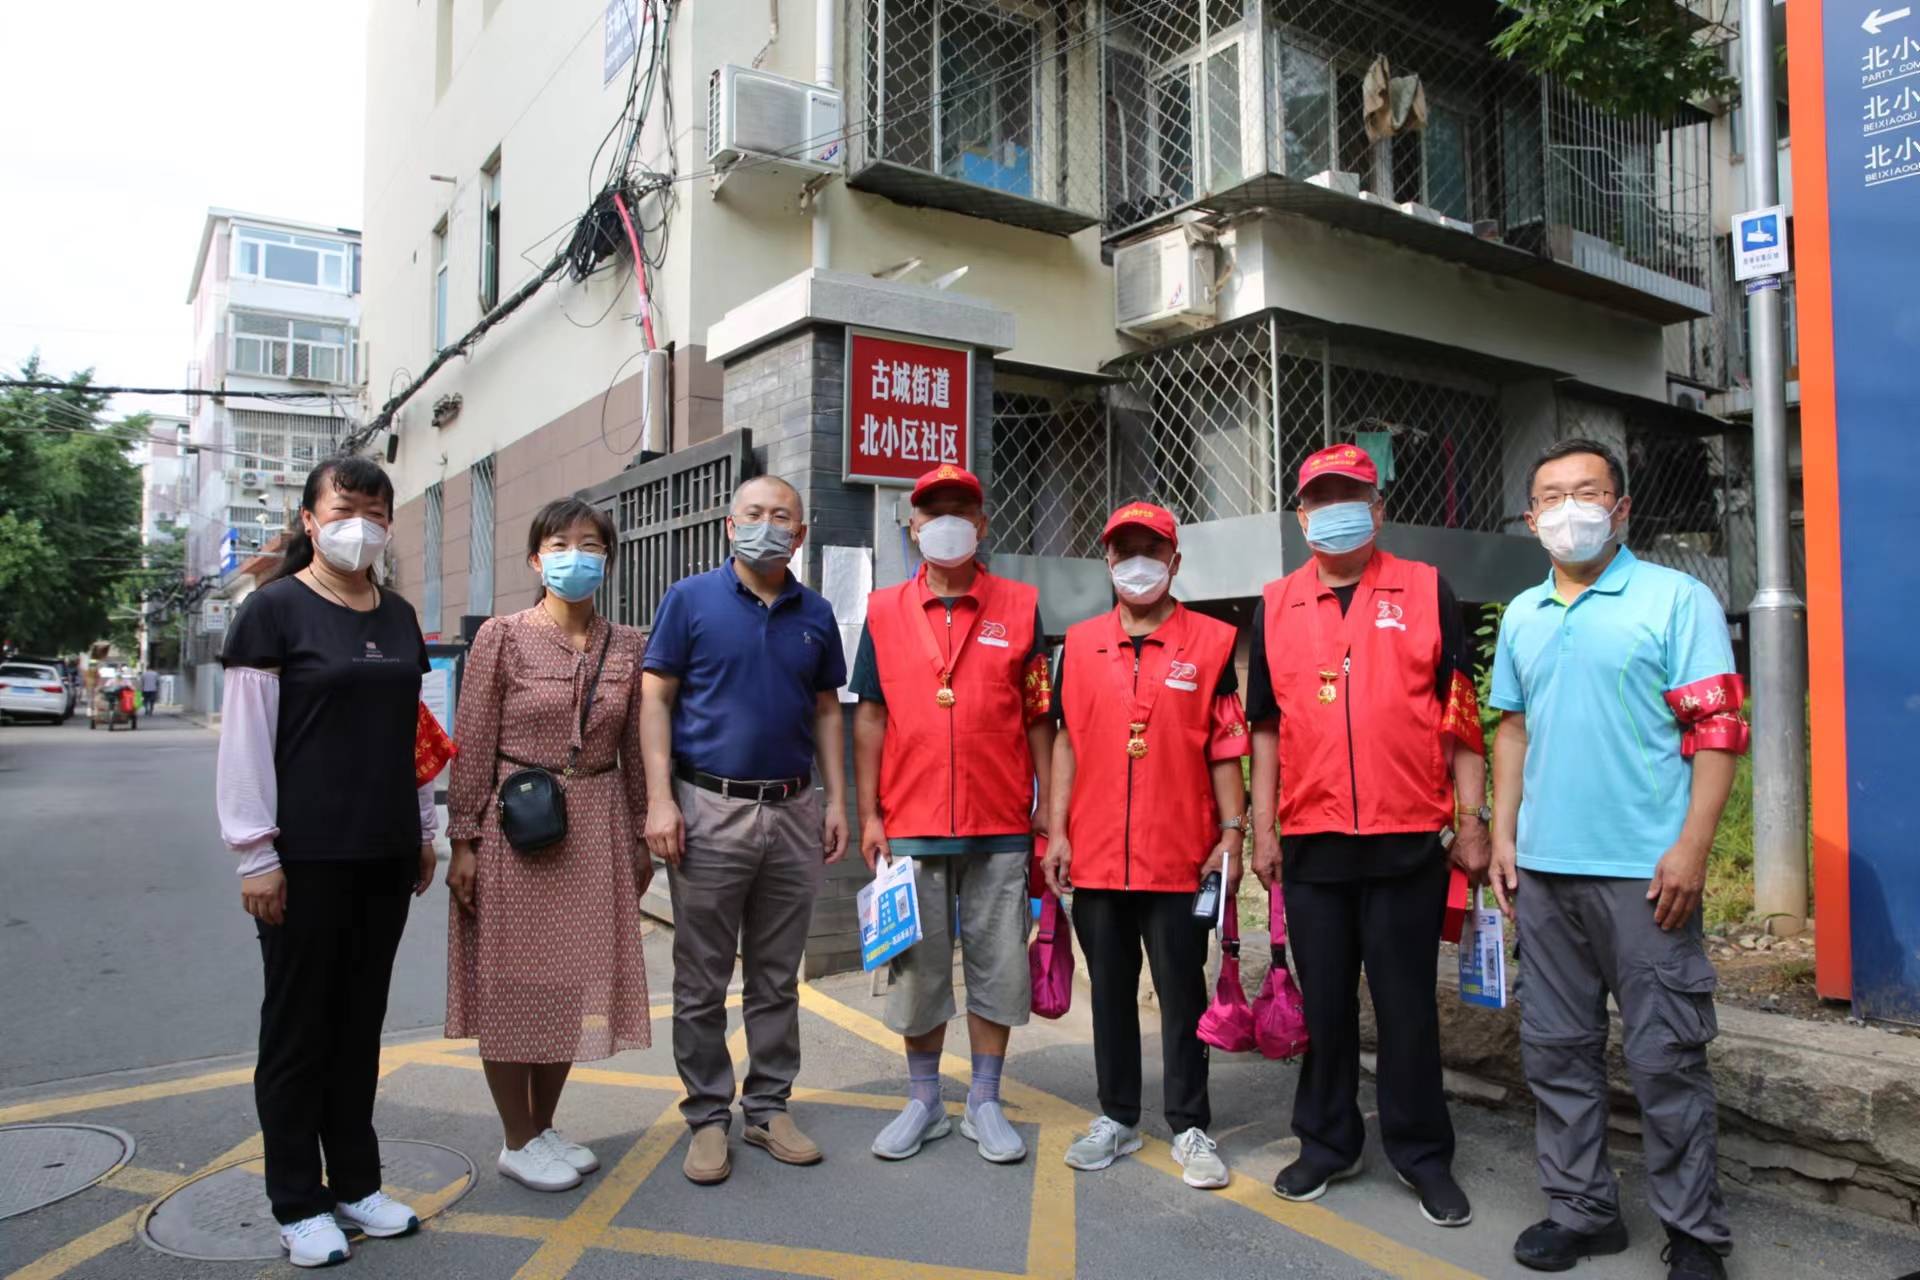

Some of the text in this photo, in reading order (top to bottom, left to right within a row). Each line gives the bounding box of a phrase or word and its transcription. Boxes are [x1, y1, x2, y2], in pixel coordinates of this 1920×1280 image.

[1862, 67, 1894, 84] PARTY
[1863, 111, 1917, 133] BEIXIAOQU
[1865, 161, 1920, 182] BEIXIAOQ
[871, 358, 950, 408] 古城街道
[859, 413, 958, 464] 北小区社区
